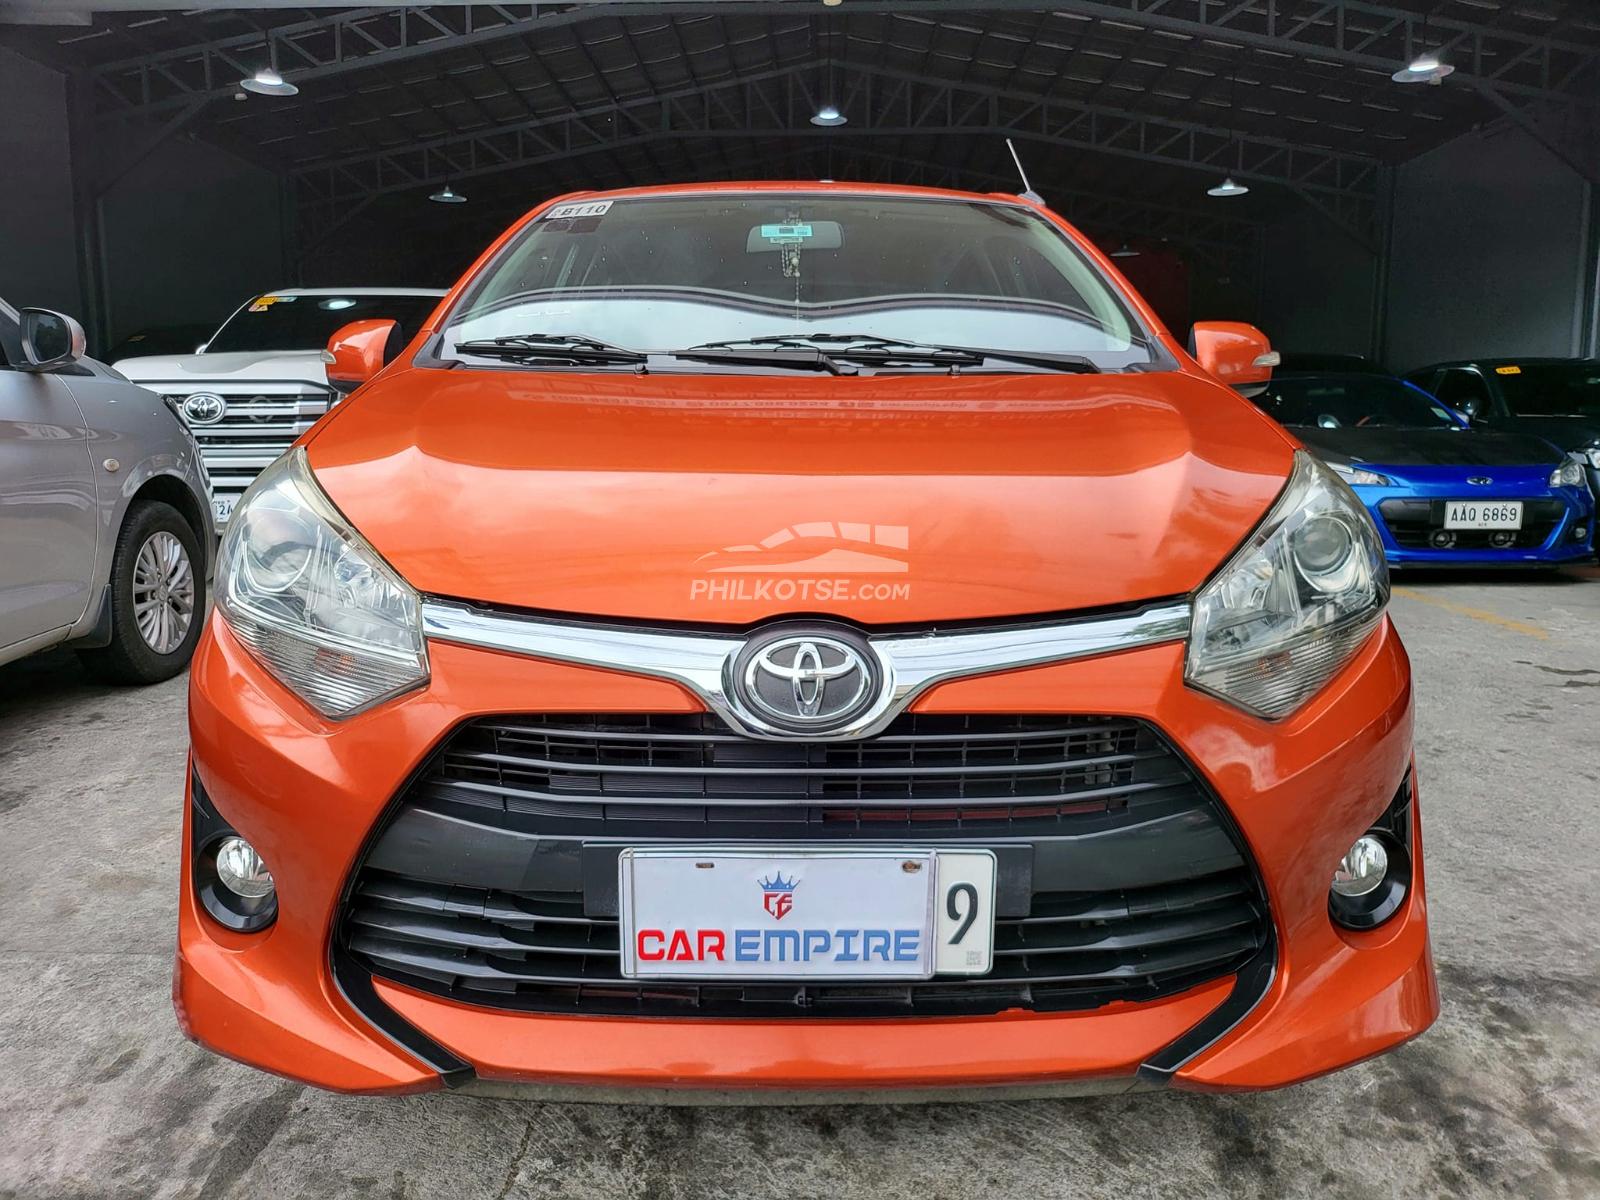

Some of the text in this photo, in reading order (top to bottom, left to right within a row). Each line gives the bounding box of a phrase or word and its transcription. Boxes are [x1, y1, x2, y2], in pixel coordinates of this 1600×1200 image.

[561, 205, 606, 216] B110
[1482, 507, 1517, 521] 6869
[946, 882, 979, 945] 9
[638, 929, 920, 961] CAR EMPIRE
